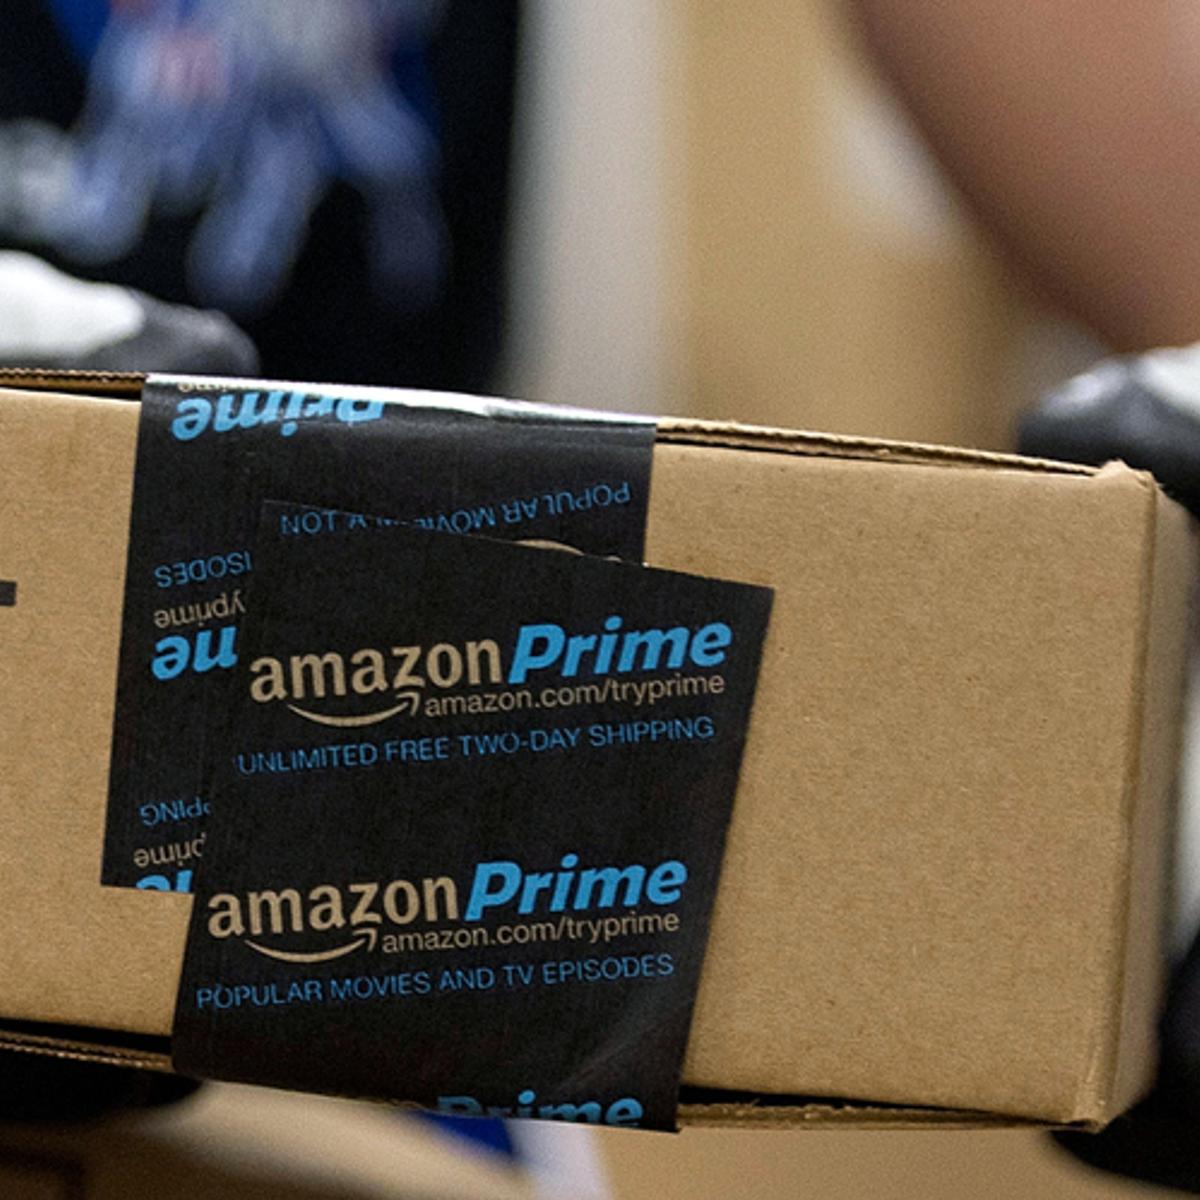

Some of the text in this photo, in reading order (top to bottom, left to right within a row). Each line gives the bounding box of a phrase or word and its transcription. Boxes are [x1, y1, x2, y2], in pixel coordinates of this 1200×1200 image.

[280, 510, 339, 535] NOT
[503, 481, 632, 525] POPULAR
[424, 671, 726, 718] amazon.com/tryprime
[237, 715, 715, 775] UNLIMITED FREE TWO-DAY SHIPPING
[382, 910, 681, 955] amazon.com/tryprime
[196, 953, 675, 1010] POPULAR MOVIES AND TV EPISODES
